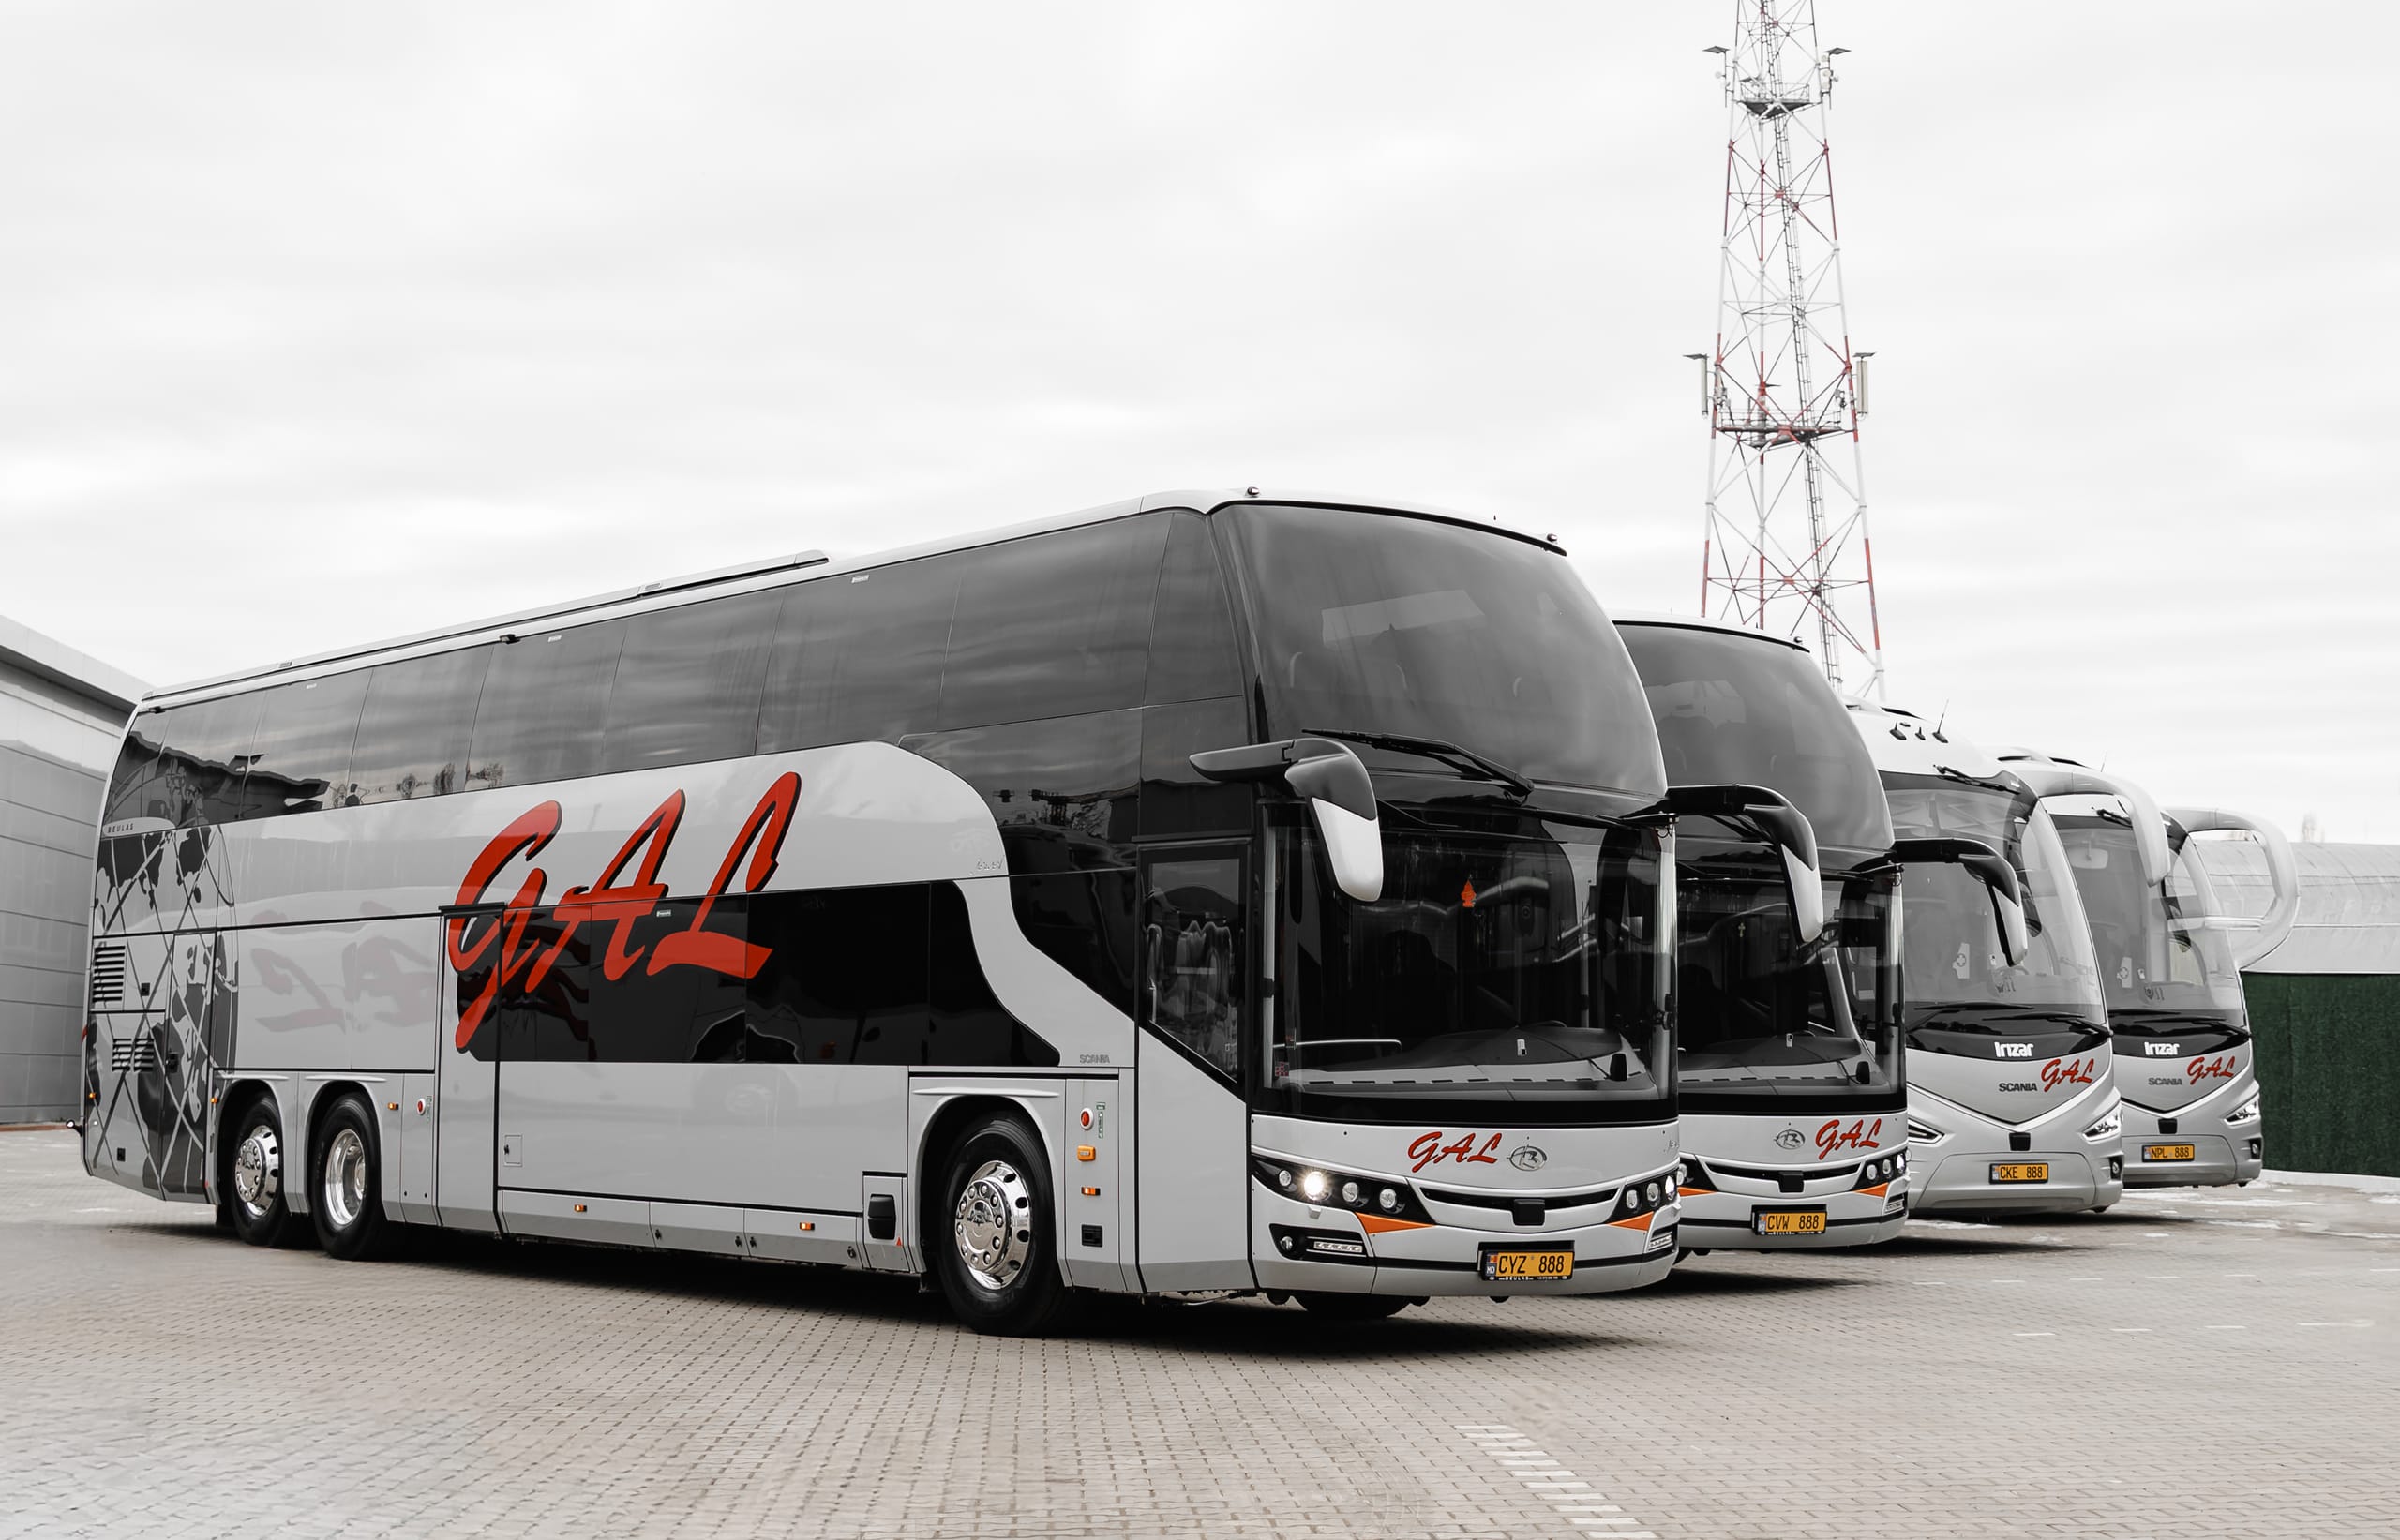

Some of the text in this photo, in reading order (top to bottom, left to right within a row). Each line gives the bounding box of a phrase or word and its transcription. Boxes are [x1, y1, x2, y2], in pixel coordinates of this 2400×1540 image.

[108, 823, 134, 833] BEULAS
[448, 771, 802, 1054] GAL
[1079, 1054, 1111, 1064] SCANIA
[2040, 1058, 2094, 1092] GAL
[2186, 1055, 2236, 1085] GAL
[1998, 1083, 2038, 1092] SCANIA
[2148, 1077, 2183, 1085] SCANIA
[1815, 1118, 1882, 1159] GAL
[1407, 1131, 1502, 1173] GAL
[2175, 1146, 2189, 1158] 888
[2000, 1167, 2018, 1178] CKE
[2026, 1166, 2043, 1178] 888
[1767, 1215, 1790, 1230] CVW
[1799, 1215, 1819, 1229] 888
[1498, 1255, 1565, 1273] CYZ 888
